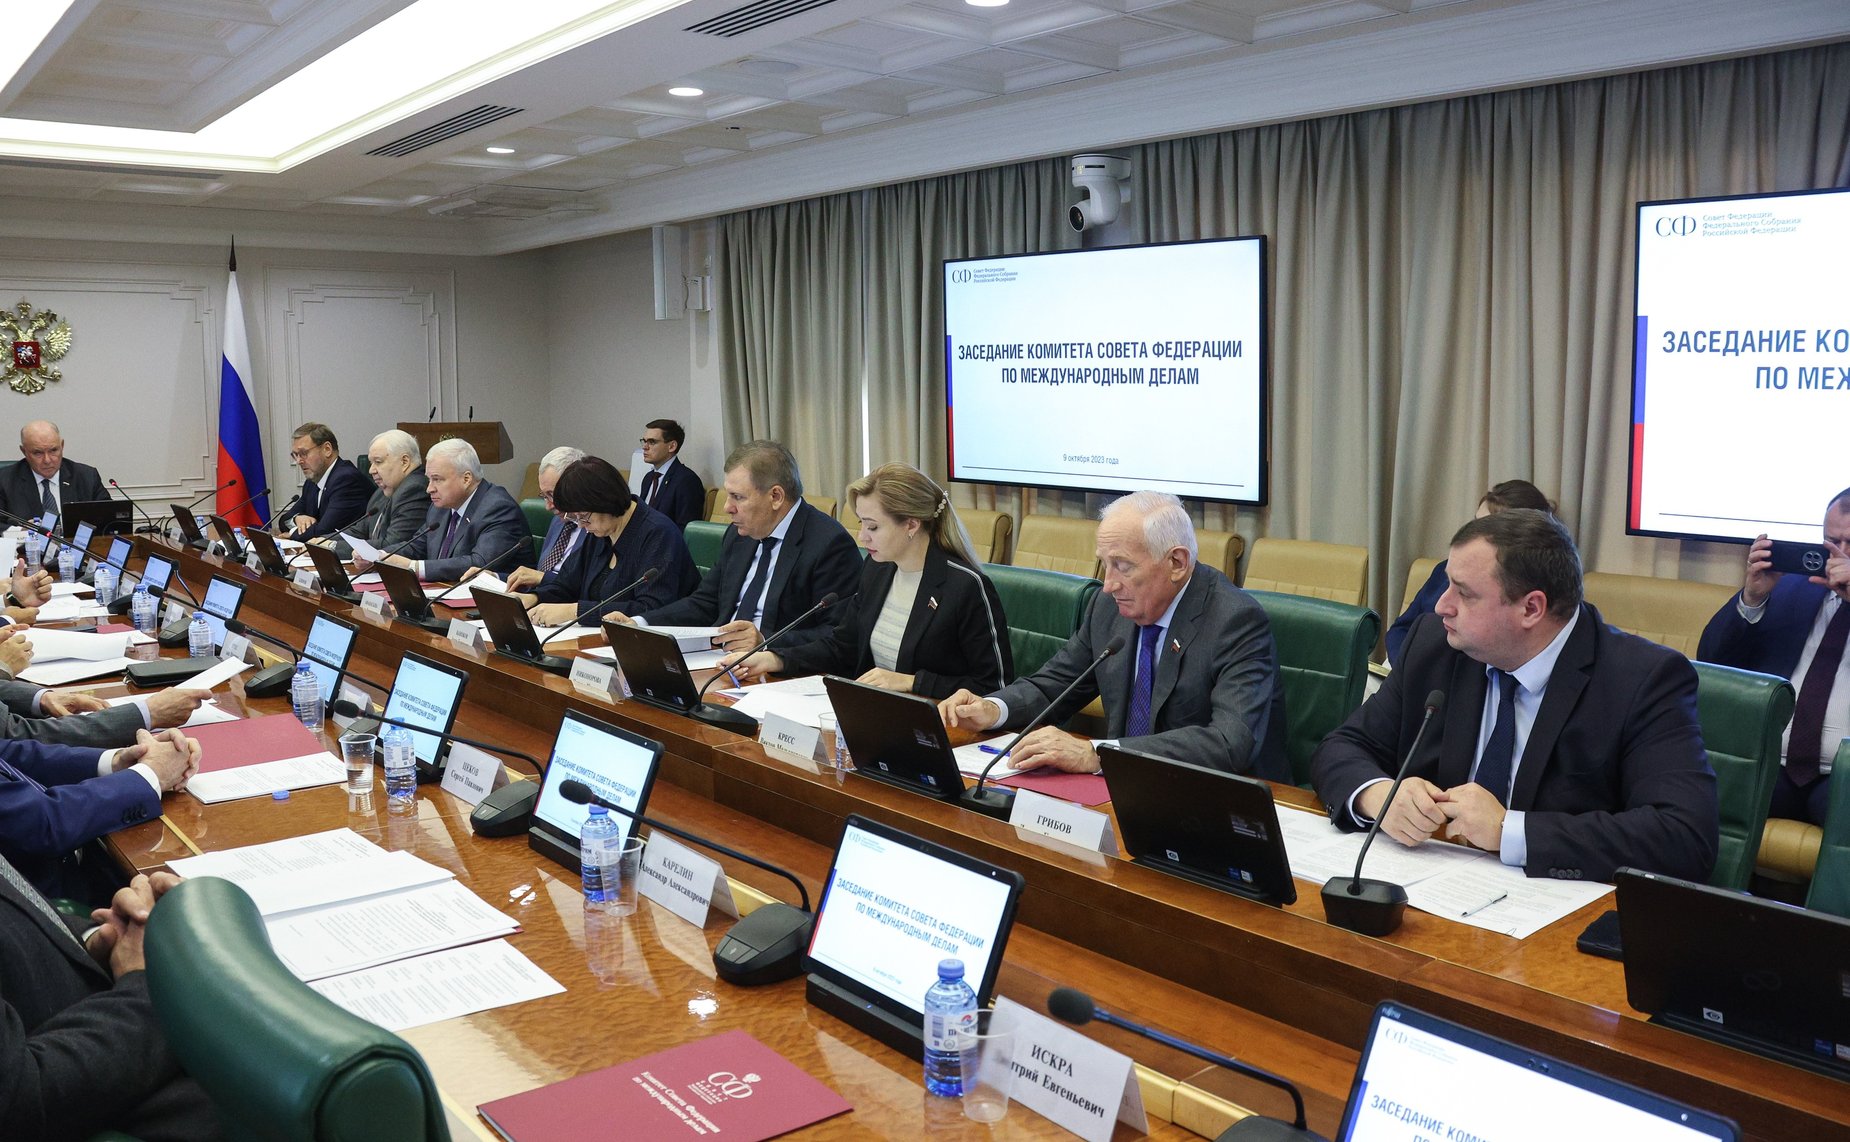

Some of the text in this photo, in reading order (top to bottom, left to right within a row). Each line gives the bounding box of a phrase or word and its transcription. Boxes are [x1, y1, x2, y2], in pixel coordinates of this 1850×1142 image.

[1656, 215, 1696, 237] СФ
[952, 269, 971, 283] СФ
[958, 340, 1242, 362] ЗАСЕДАНИЕ КОМИТЕТА СОВЕТА ФЕДЕРАЦИИ
[1662, 330, 1806, 357] ЗАСЕДАНИЕ
[1002, 367, 1199, 387] ПО МЕЖДУНАРОДНЫМ ДЕЛАМ
[1756, 367, 1788, 389] ПО
[1091, 455, 1104, 463] 2023
[777, 732, 796, 745] КРЕСС
[1036, 814, 1072, 834] ГРИБОВ
[662, 857, 694, 881] КАРЕЛИН
[639, 862, 709, 907] Александр Александрович
[836, 878, 985, 949] ЗАСЕДАНИЕ КОМИТЕТА СОВЕТА ФЕДЕРАЦИИ
[855, 902, 959, 955] ПО МЕЖДУНАРОДНЫМ ДЕЛАМ
[1031, 1044, 1073, 1077] ИСКРА
[708, 1071, 753, 1099] СФ
[1042, 1073, 1105, 1118] Евгеньевич
[1370, 1094, 1445, 1136] ЗАСЕДАНИЕ
